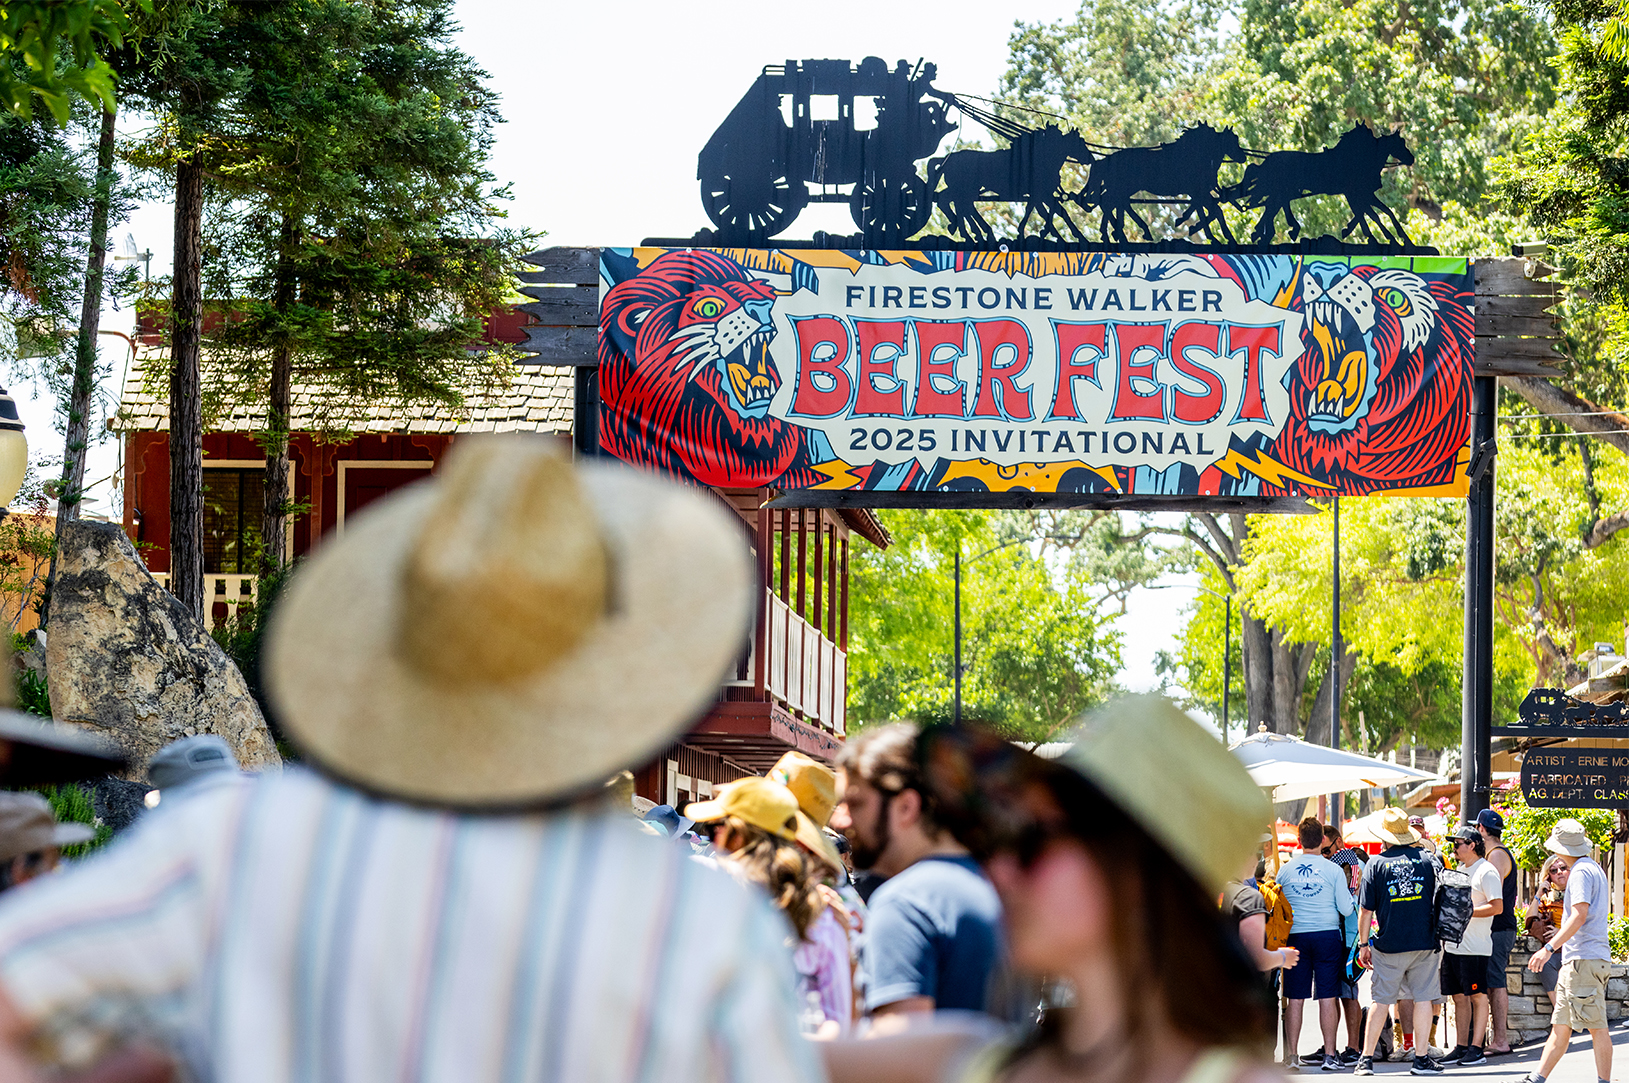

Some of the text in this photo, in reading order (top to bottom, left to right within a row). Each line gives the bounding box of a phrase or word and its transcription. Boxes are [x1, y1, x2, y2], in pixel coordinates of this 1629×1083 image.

[846, 285, 1223, 312] FIRESTONE WALKER
[785, 313, 1286, 427] BEER FEST
[849, 427, 1214, 455] 2025 INVITATIONAL
[1526, 755, 1566, 766] ARTIST
[1578, 756, 1608, 767] ERNIE
[1531, 774, 1607, 785] FABRICATED
[1528, 788, 1548, 799] AG.
[1552, 788, 1585, 799] DEPT.
